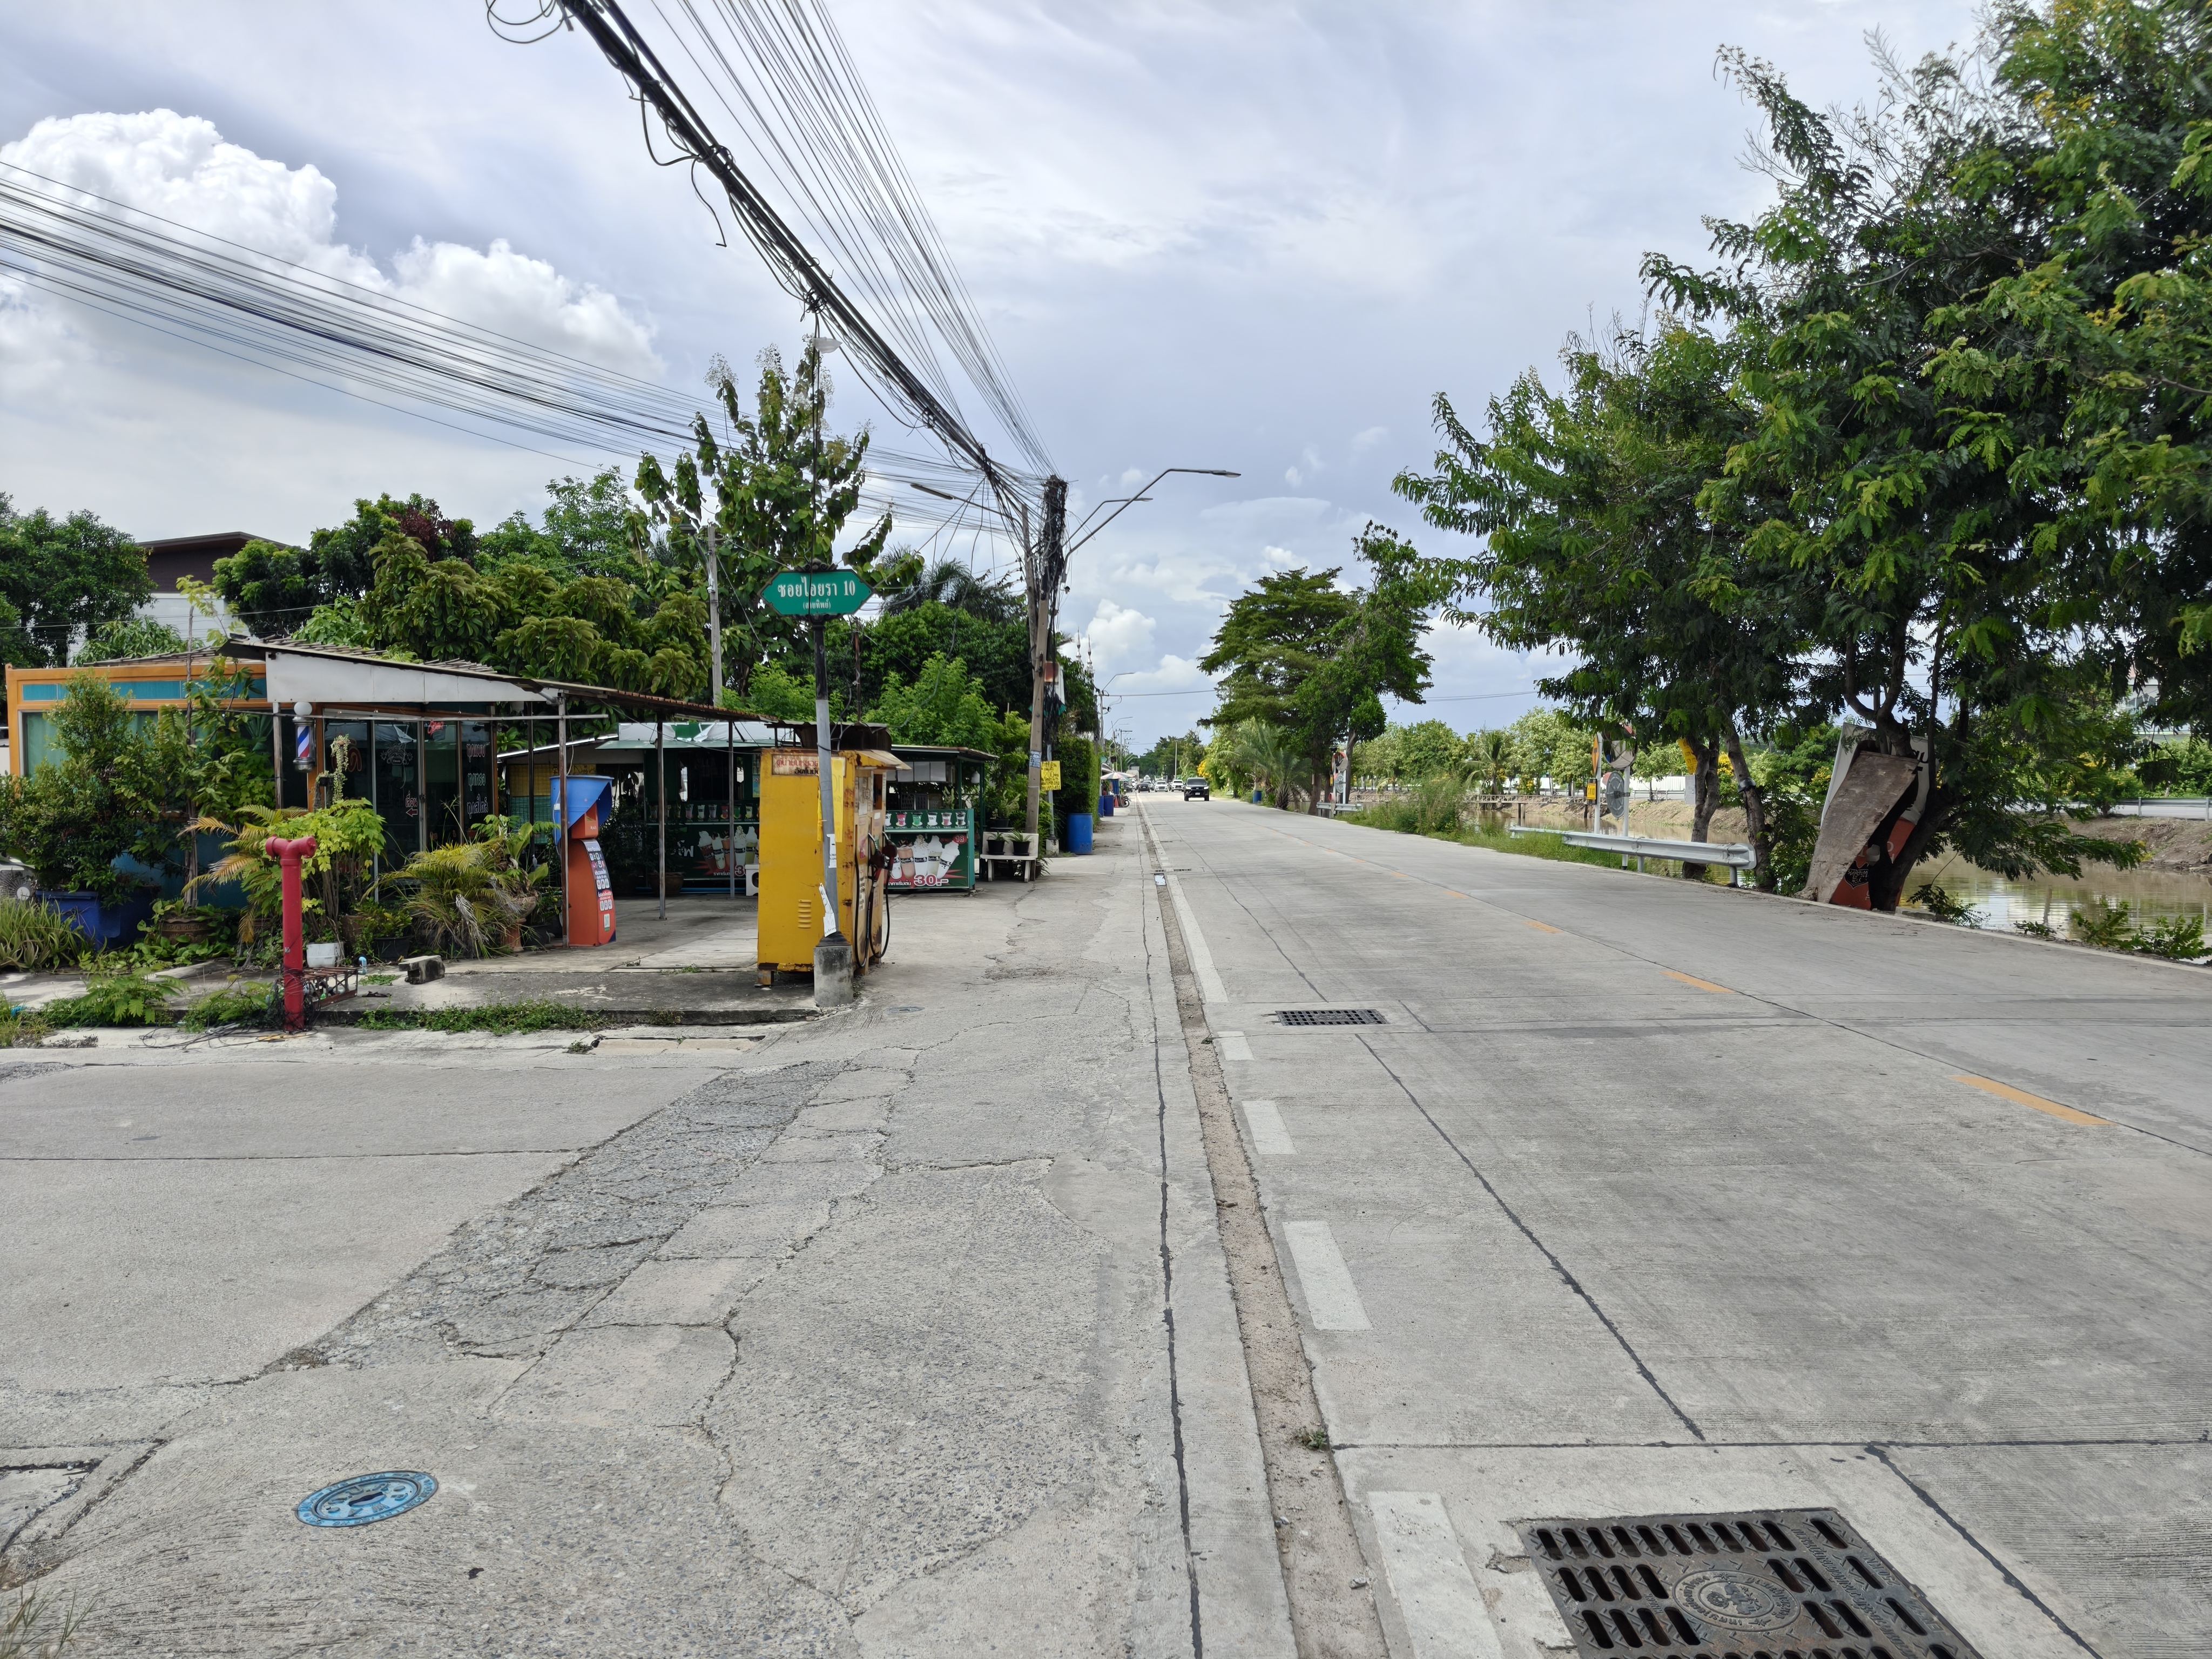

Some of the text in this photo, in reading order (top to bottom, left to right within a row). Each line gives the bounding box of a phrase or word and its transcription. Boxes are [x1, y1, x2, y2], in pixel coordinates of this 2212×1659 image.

[778, 576, 855, 597] ซอยไอยรา 10
[776, 756, 818, 767] ตู้น้ำมันหยอด
